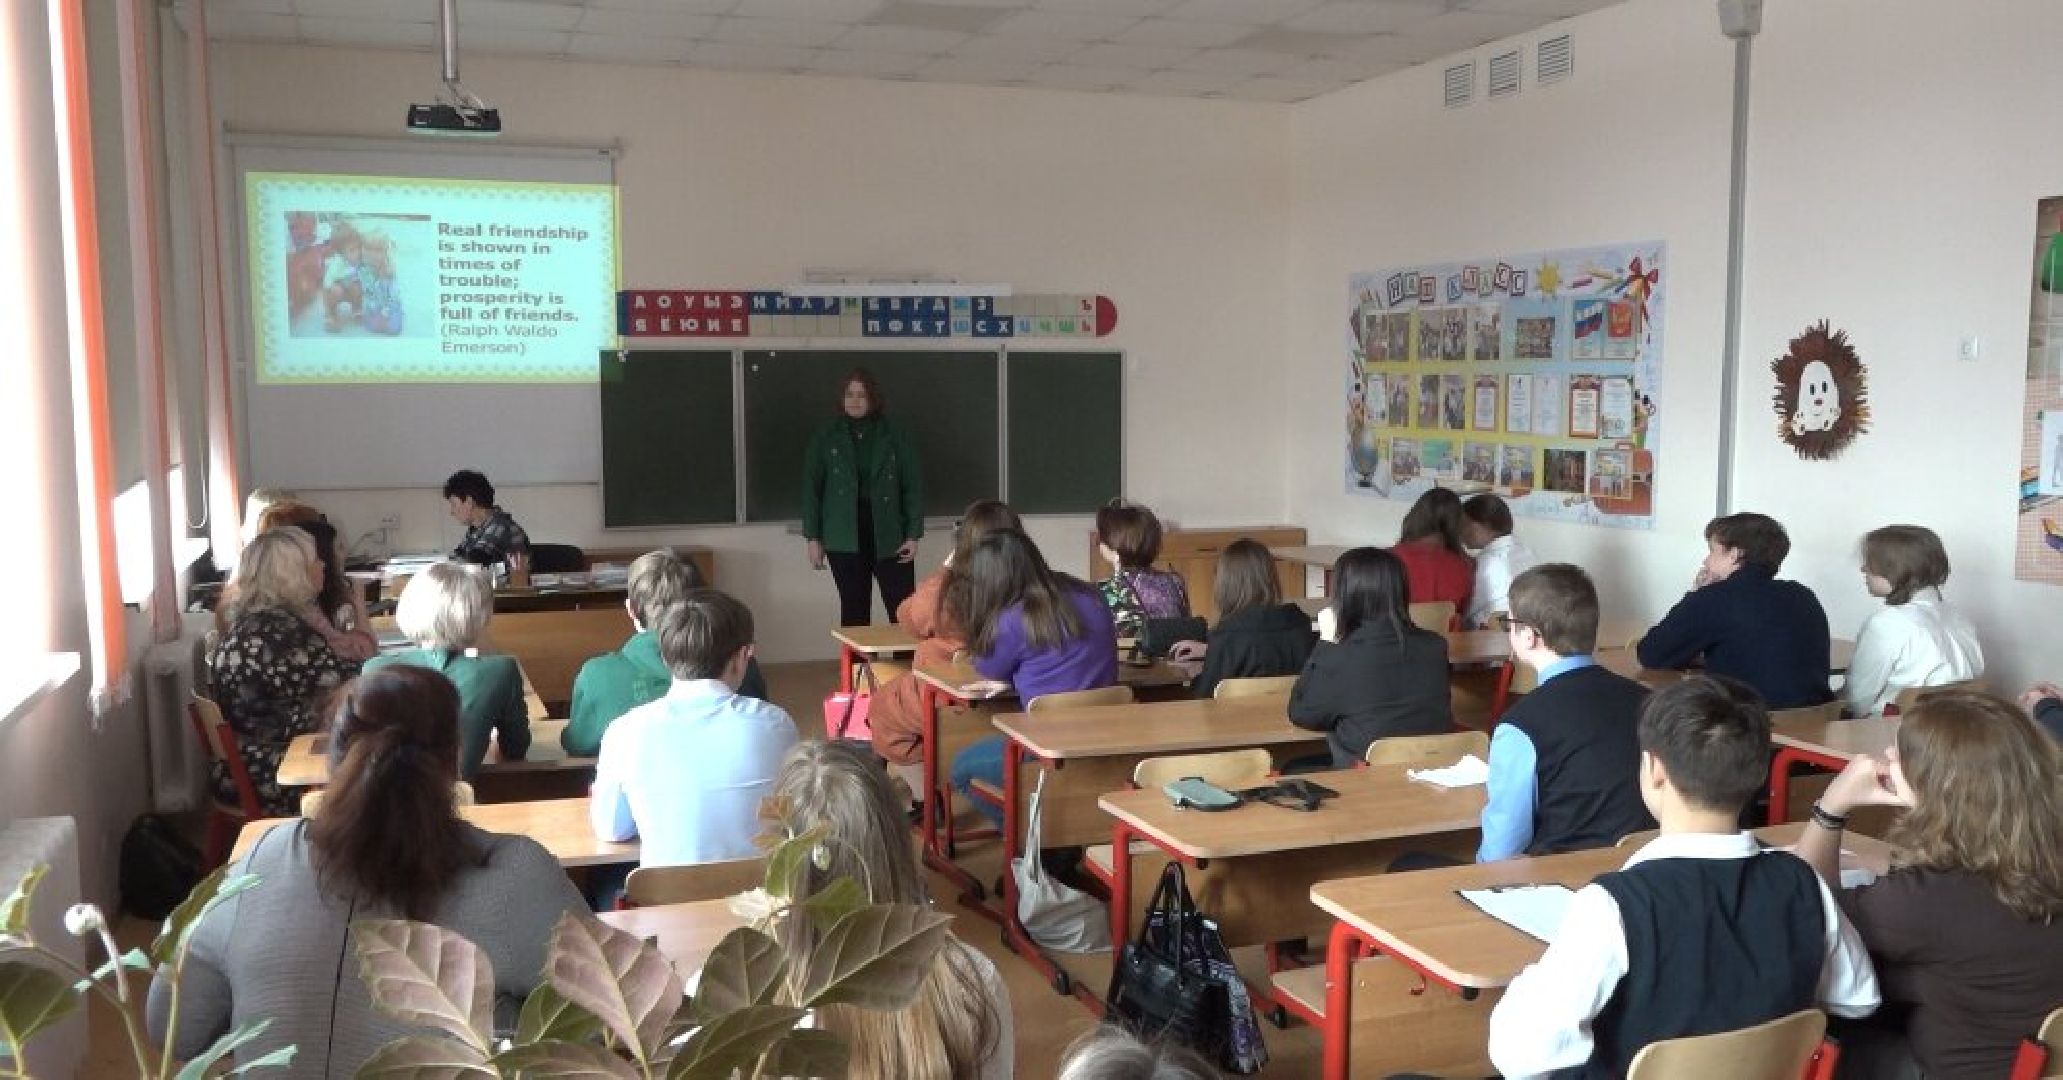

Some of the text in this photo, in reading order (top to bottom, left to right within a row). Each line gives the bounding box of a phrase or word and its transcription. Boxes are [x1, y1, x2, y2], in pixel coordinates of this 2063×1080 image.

[438, 222, 589, 242] Real friendship
[438, 240, 551, 254] is shown in
[438, 257, 522, 270] times of
[439, 274, 518, 289] trouble;
[440, 292, 564, 306] prosperity is
[440, 308, 579, 322] full of friends.
[441, 324, 558, 338] (Ralph Waldo
[442, 341, 526, 356] Emerson)
